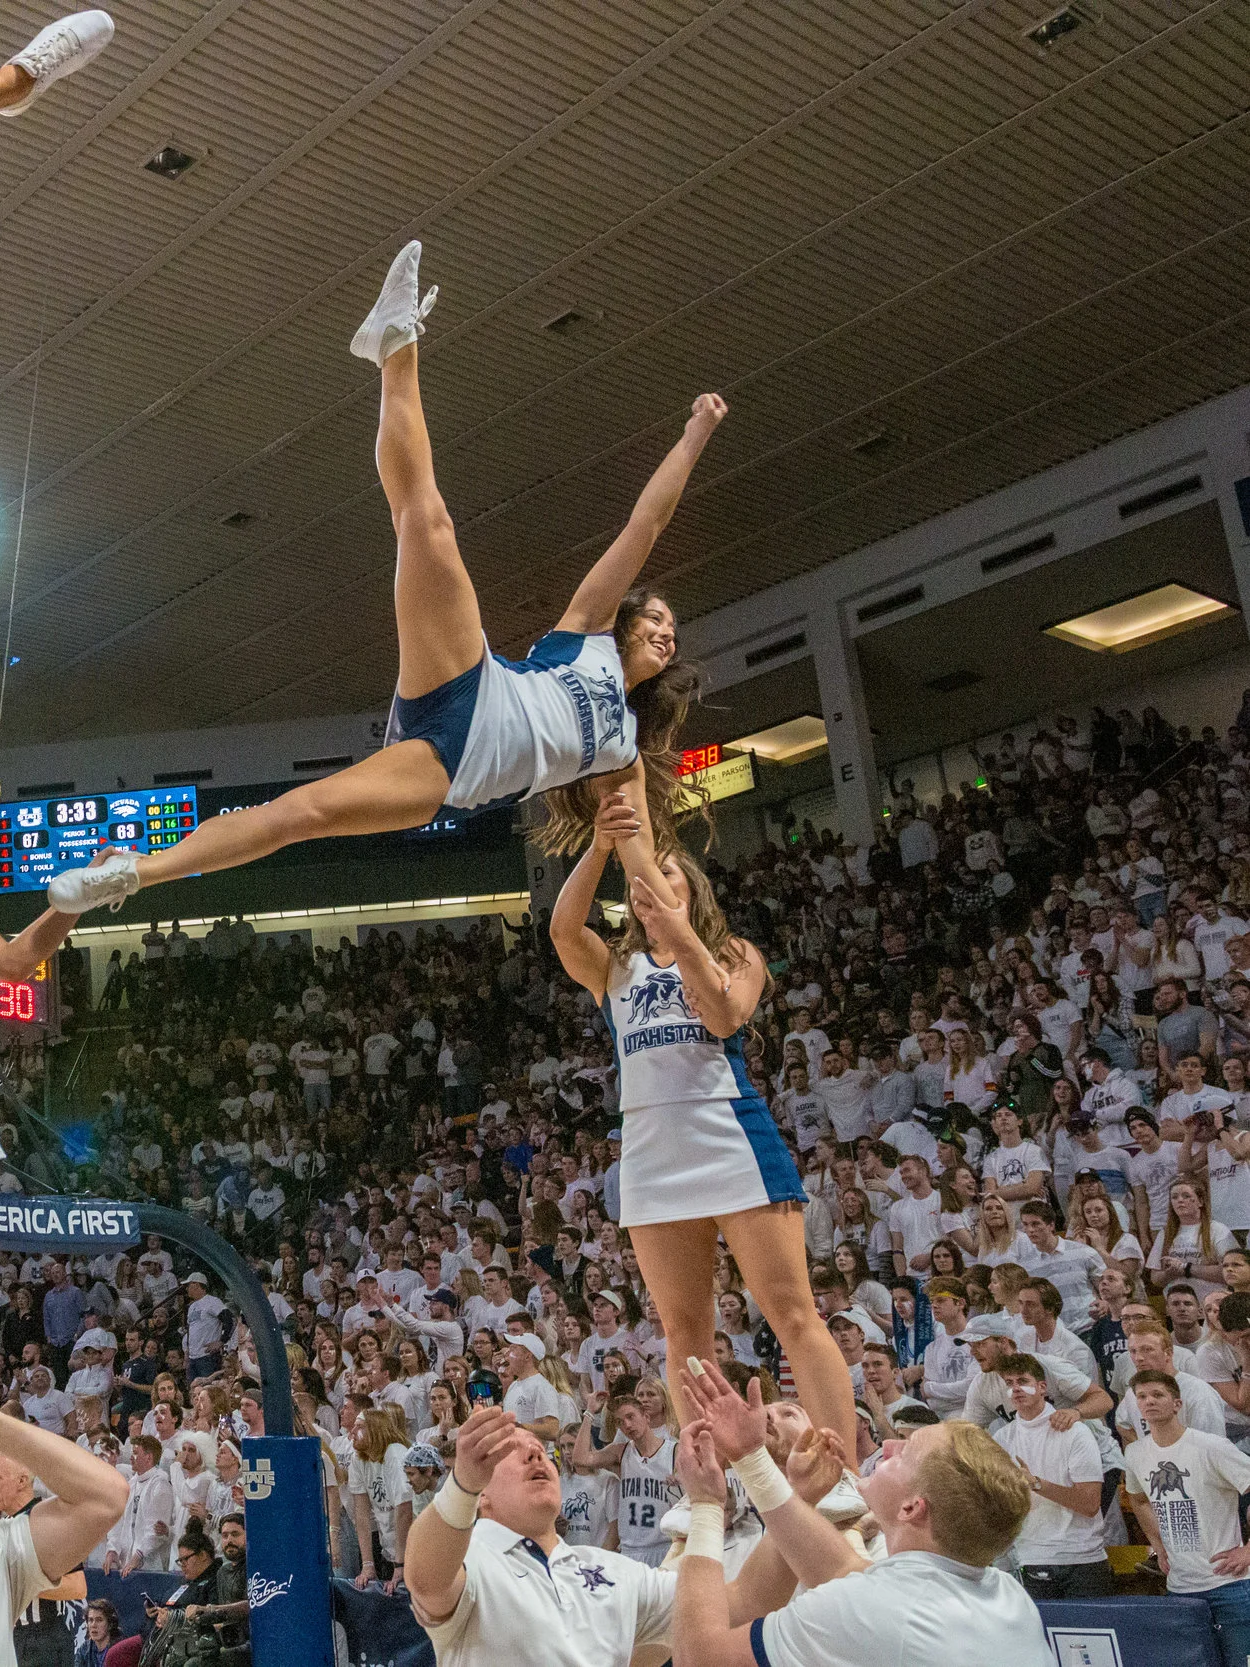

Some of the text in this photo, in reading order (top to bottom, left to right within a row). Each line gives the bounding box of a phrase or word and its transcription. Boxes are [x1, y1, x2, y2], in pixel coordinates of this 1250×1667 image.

[558, 670, 594, 722] UTAH
[721, 763, 750, 779] PARSON
[840, 763, 855, 783] E
[110, 798, 140, 810] NEVADA
[148, 806, 161, 815] 00
[164, 804, 175, 814] 21
[56, 801, 97, 824] 3:33
[150, 820, 161, 830] 10
[166, 819, 176, 828] 16
[63, 830, 86, 838] PERIOD
[117, 823, 136, 840] 63
[59, 838, 98, 848] POSSESSION
[151, 835, 161, 844] 11
[166, 833, 177, 843] 11
[30, 852, 53, 860] BONUS
[20, 864, 54, 873] 10 FOULS
[533, 866, 545, 881] D
[0, 982, 33, 1019] 30
[623, 1025, 663, 1057] UTAH
[67, 1210, 134, 1236] FIRST
[1169, 1500, 1196, 1508] STATE
[629, 1503, 655, 1528] 12
[1170, 1508, 1197, 1516] STATE
[1170, 1515, 1198, 1523] STATE
[1171, 1523, 1199, 1531] STATE
[1172, 1531, 1200, 1539] STATE
